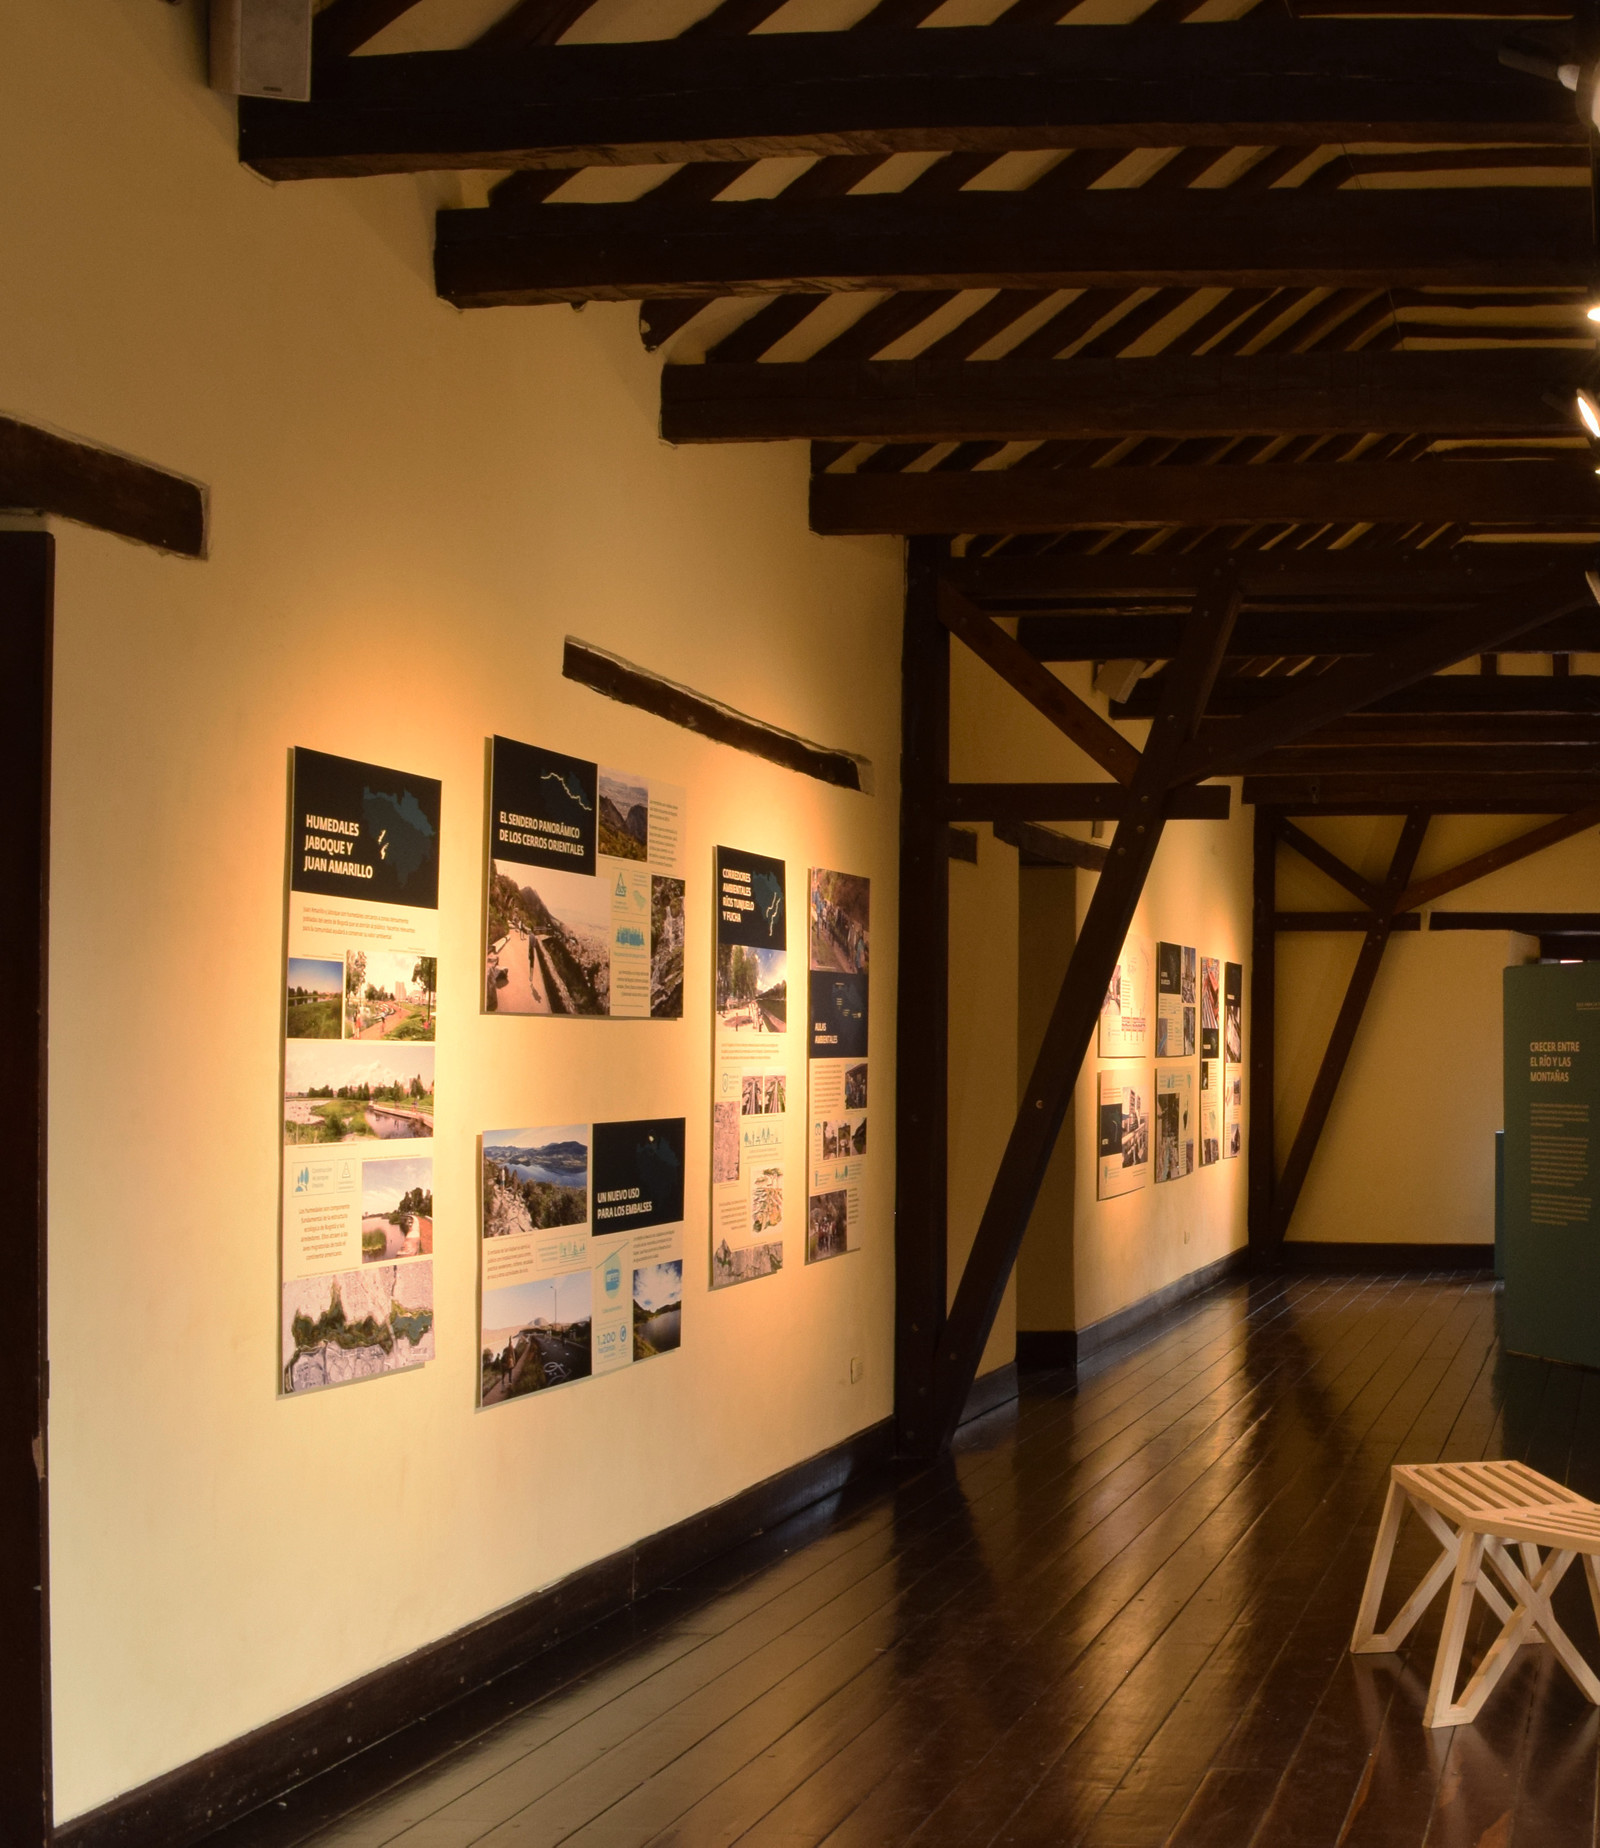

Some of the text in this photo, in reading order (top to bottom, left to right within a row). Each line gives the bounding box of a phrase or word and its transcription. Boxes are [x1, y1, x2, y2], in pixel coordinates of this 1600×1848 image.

[306, 814, 360, 837] HUMEDALES
[499, 811, 581, 839] EL SENDERO PANORÁMICO
[304, 835, 354, 856] JABOQUE Y
[499, 828, 585, 857] DE LOS CERROS ORIENTALES
[303, 855, 374, 879] JUAN AMARILLO
[1530, 1041, 1580, 1053] CRECER ENTRE
[1530, 1054, 1571, 1067] EL RÍO Y LAS
[1530, 1069, 1570, 1082] MONTAÑAS
[597, 1187, 641, 1204] UN NUEVO USO
[597, 1201, 653, 1220] PARA LOS EMBALSES
